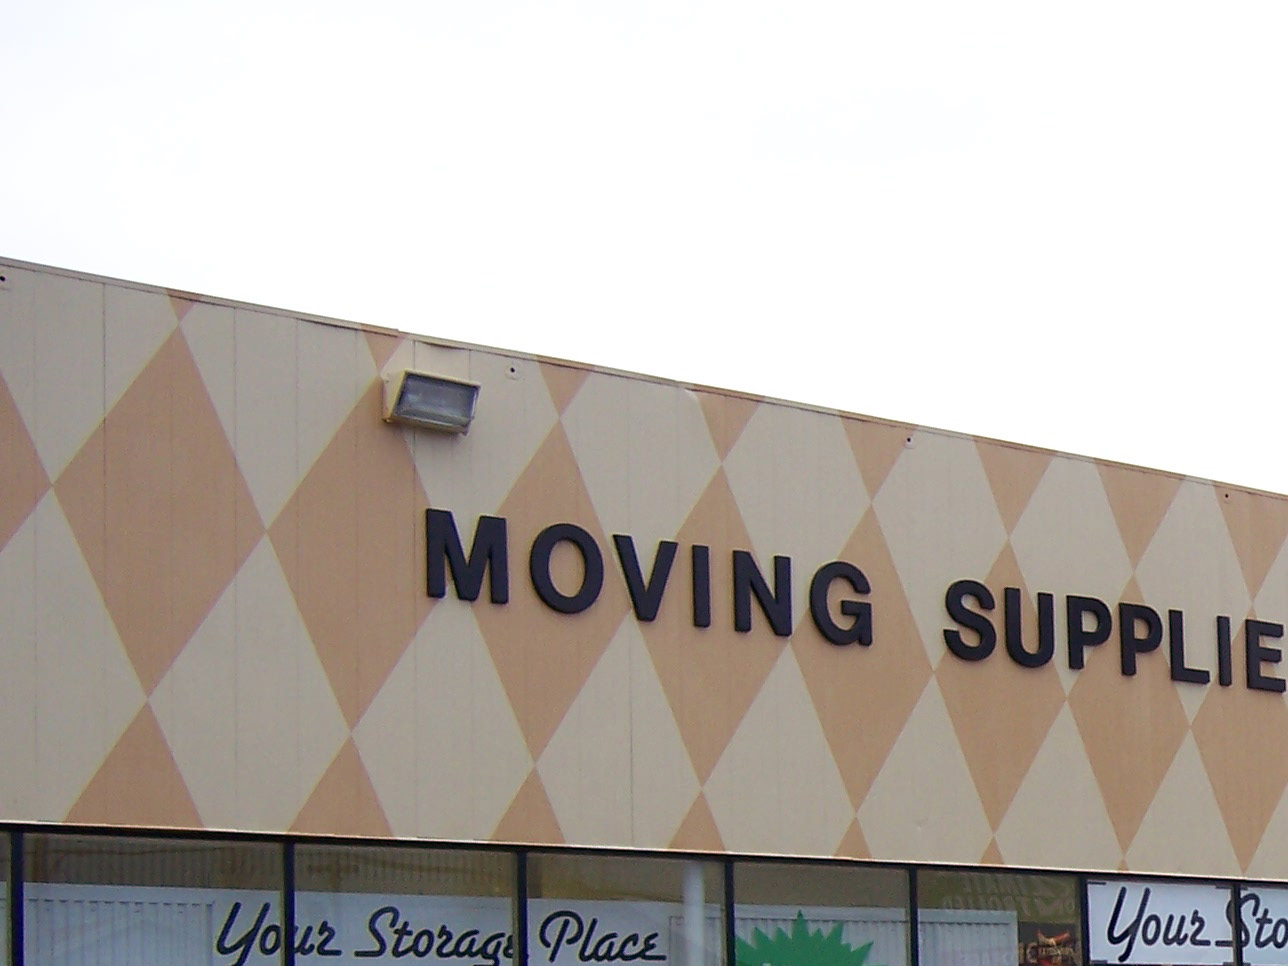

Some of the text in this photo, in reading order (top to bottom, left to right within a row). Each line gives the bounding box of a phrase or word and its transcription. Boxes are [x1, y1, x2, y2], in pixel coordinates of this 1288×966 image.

[425, 508, 873, 647] MOVING
[538, 909, 667, 963] Place
[1107, 886, 1211, 962] Your
